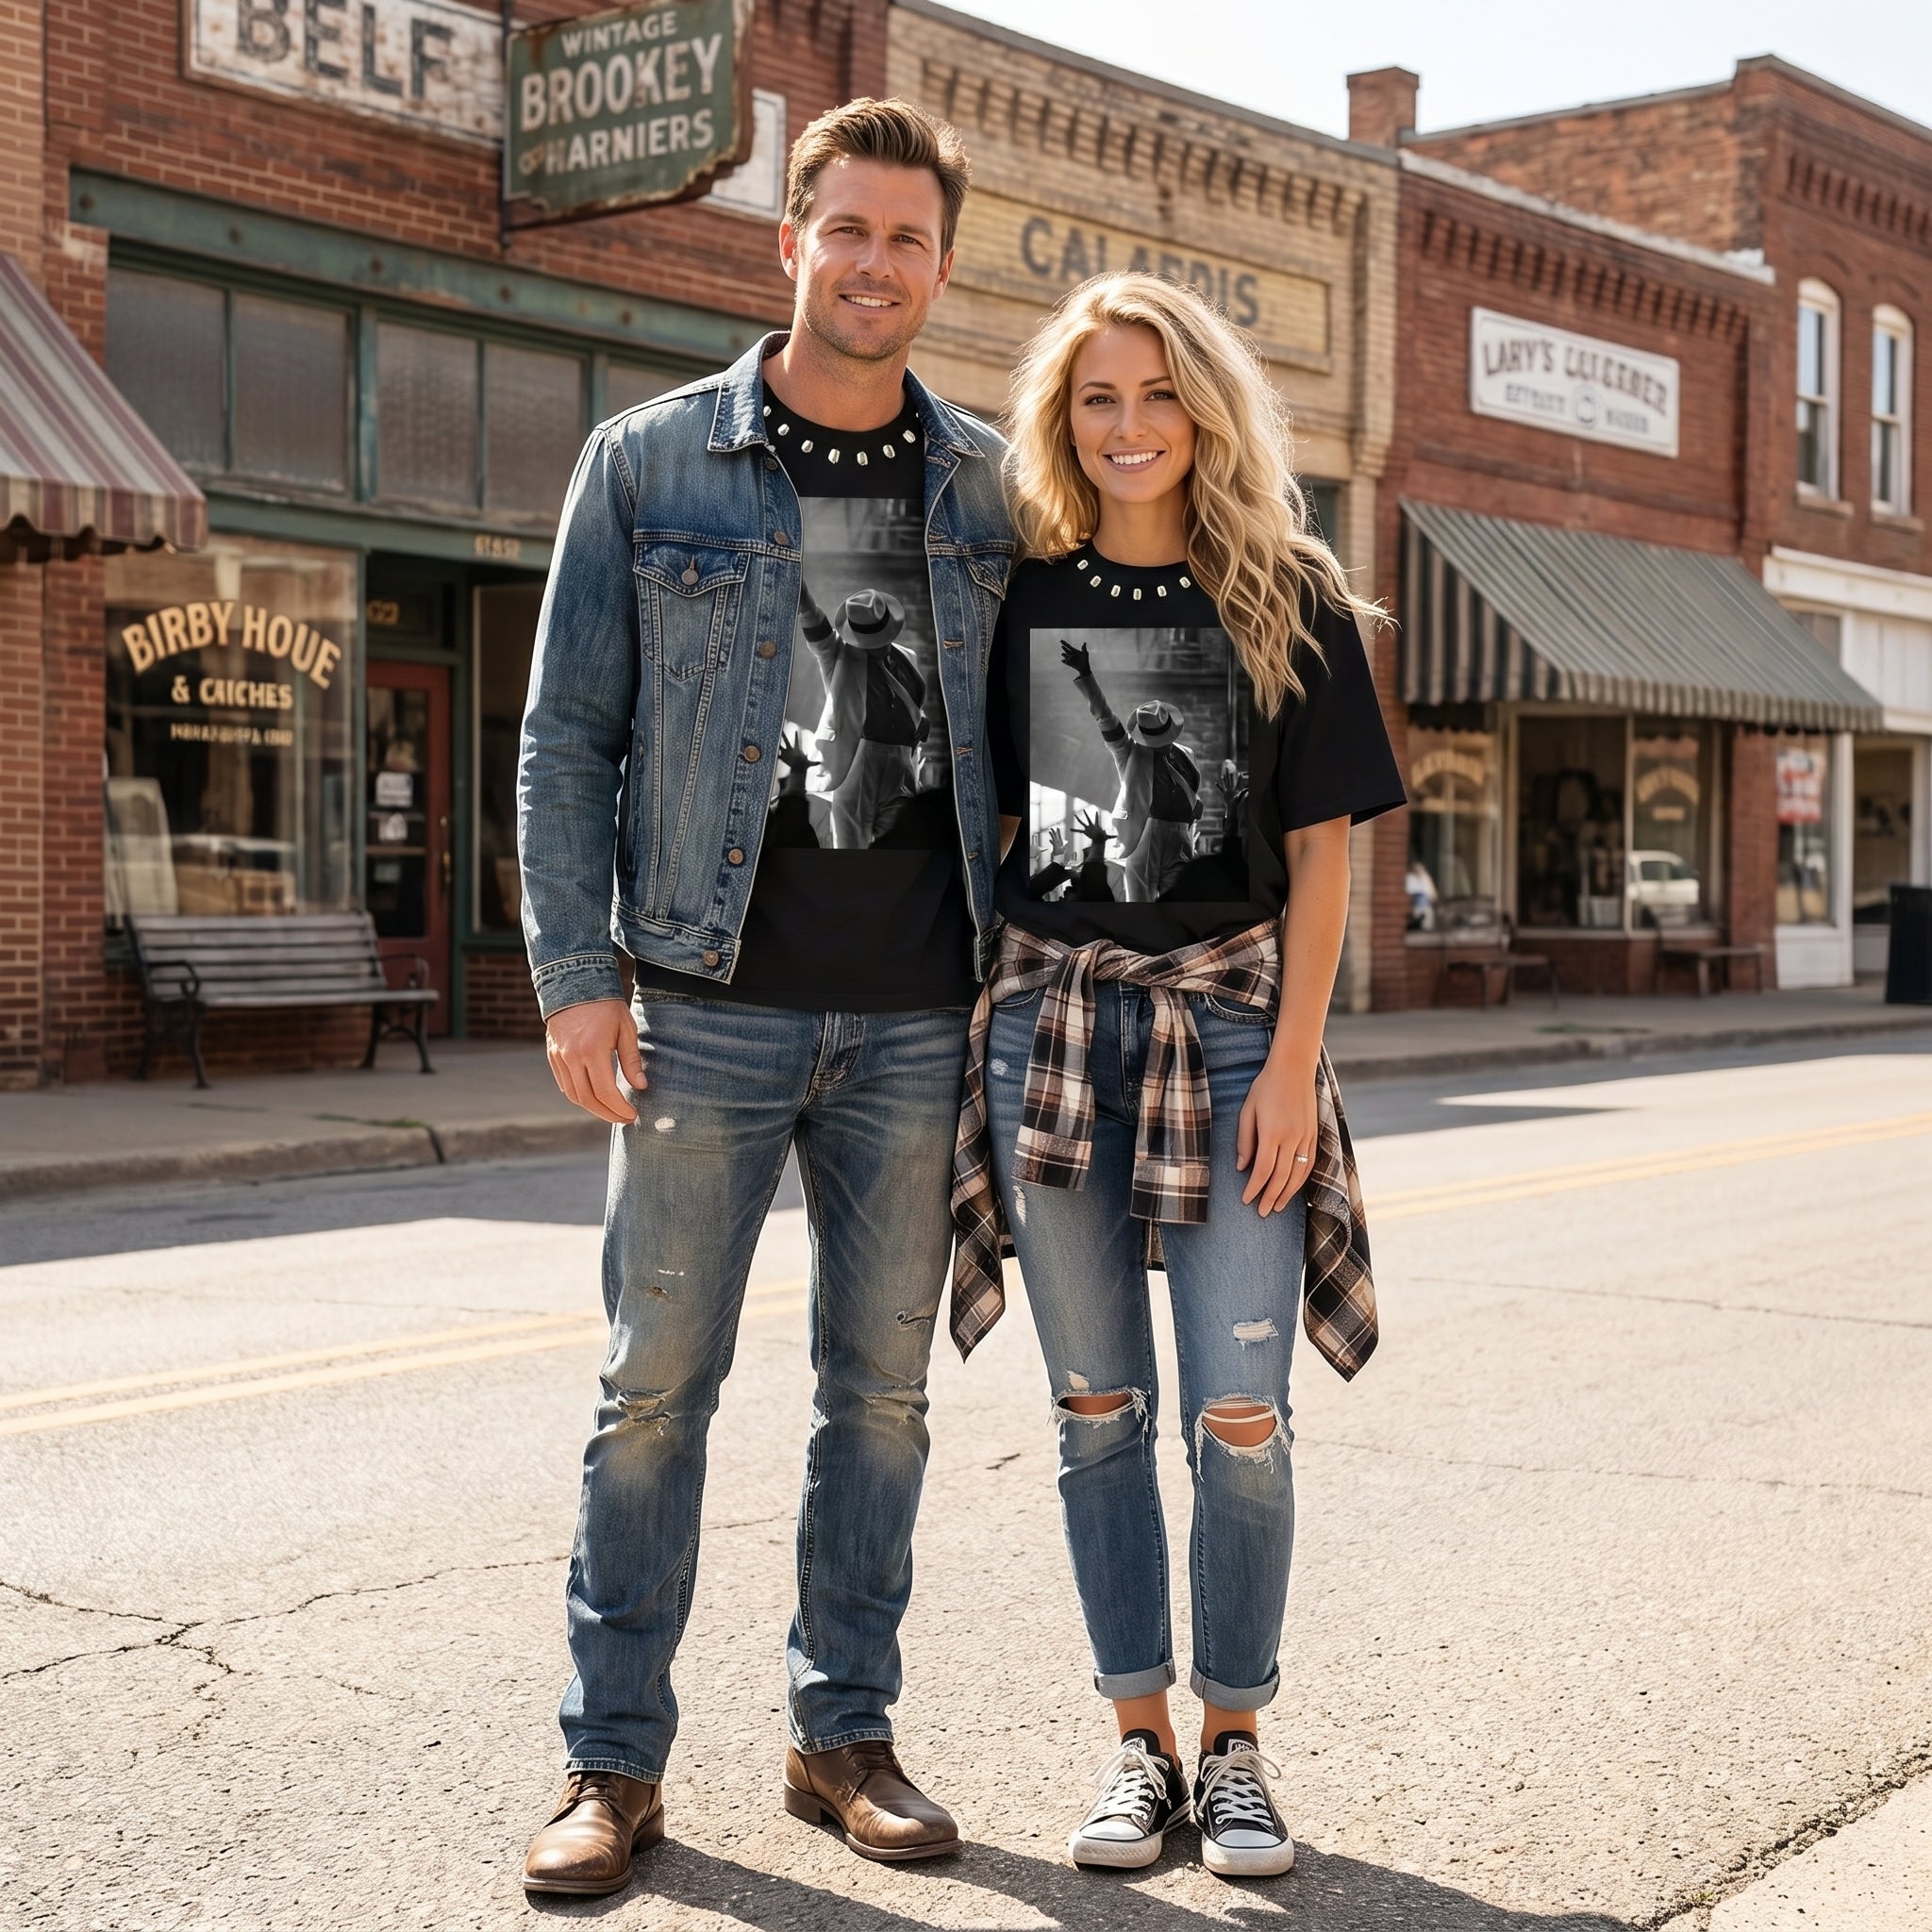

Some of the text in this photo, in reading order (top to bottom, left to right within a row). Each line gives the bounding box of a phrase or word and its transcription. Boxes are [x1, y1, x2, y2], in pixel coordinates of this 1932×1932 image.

[561, 10, 677, 58] WINTAGE
[521, 33, 723, 132] BROOKEY
[122, 601, 341, 691] BIRBY HOUE
[171, 675, 191, 704] &
